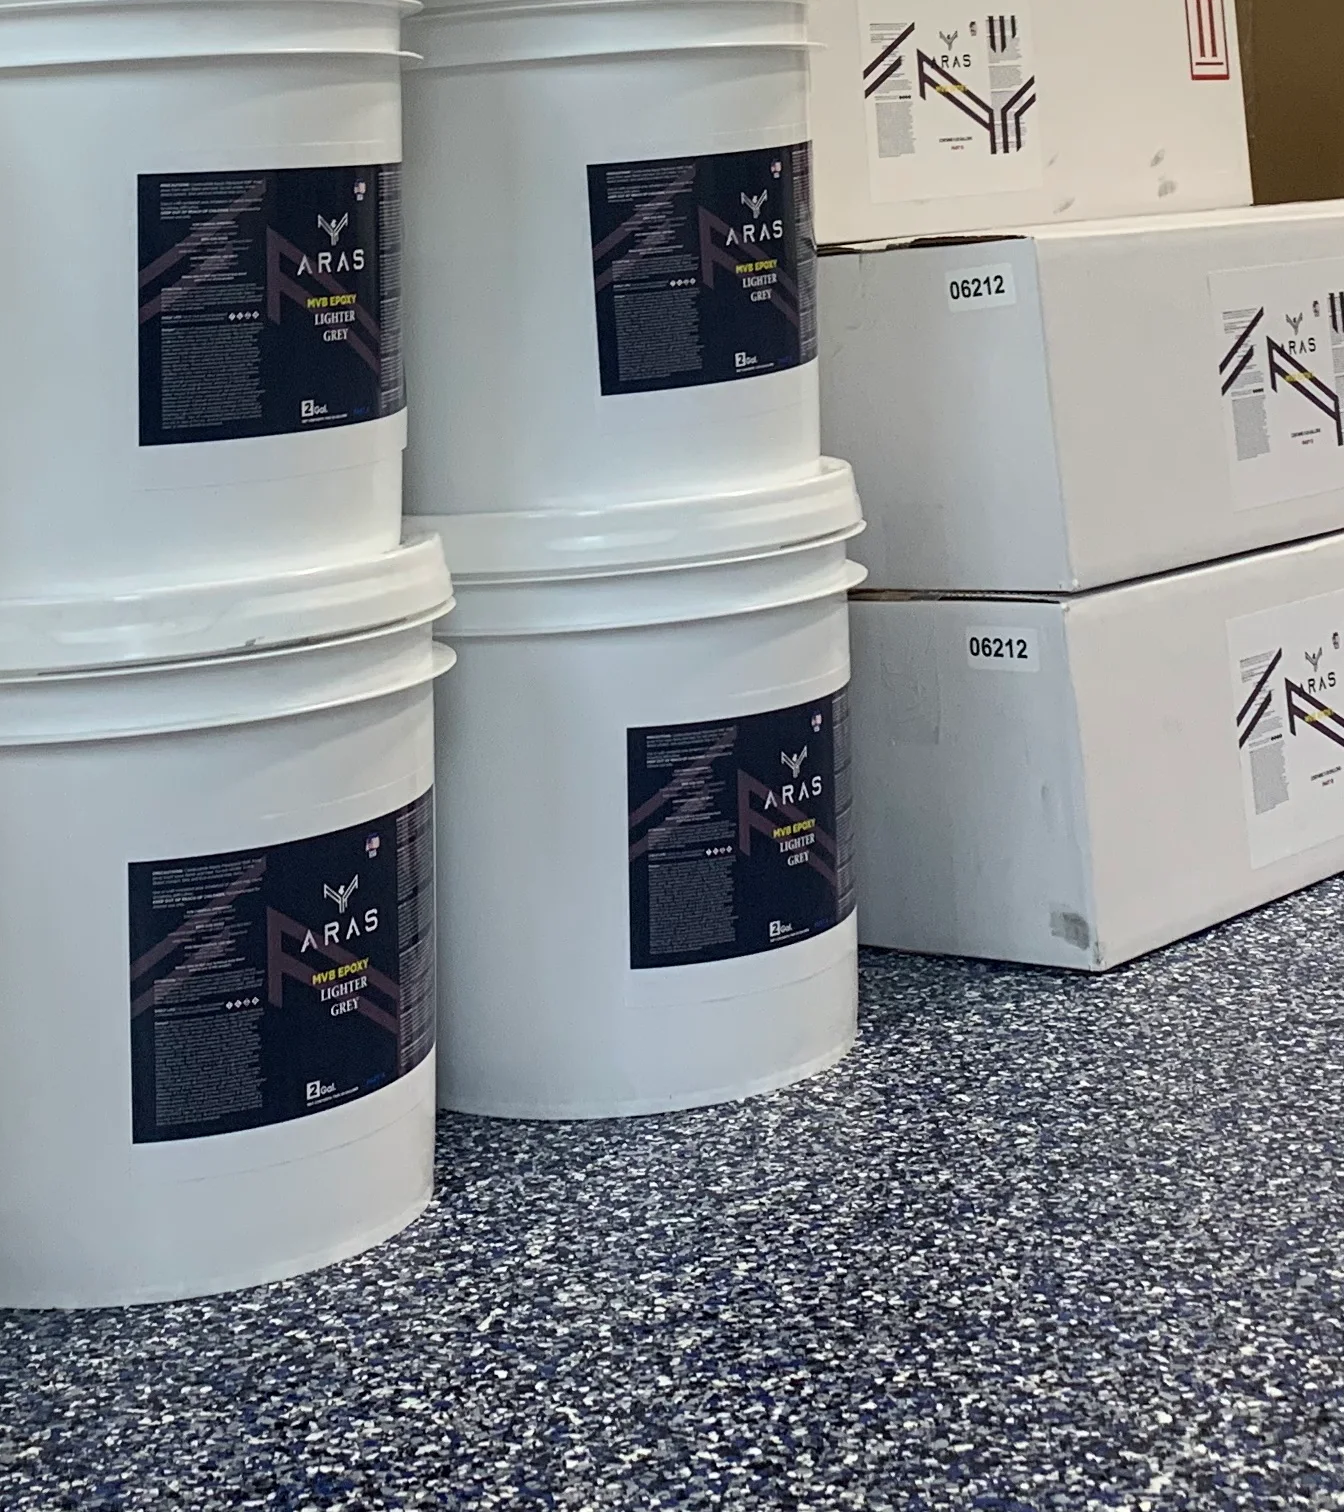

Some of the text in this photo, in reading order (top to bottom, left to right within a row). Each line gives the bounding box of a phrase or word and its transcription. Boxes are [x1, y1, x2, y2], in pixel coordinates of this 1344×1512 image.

[726, 220, 783, 246] ARAS
[297, 249, 365, 276] ARAS
[742, 274, 777, 288] LIGHTER
[949, 274, 1005, 301] 06212
[307, 293, 356, 309] MVB EPOXY
[750, 289, 772, 302] GREY
[314, 310, 355, 326] LIGHTER
[323, 328, 348, 342] GREY
[969, 635, 1028, 660] 06212
[764, 776, 822, 809] ARAS
[779, 833, 815, 853] LIGHTER
[787, 850, 809, 867] GREY
[300, 908, 378, 953] ARAS
[312, 957, 370, 986] MVB EPOXY
[320, 975, 368, 1002] LIGHTER
[330, 996, 360, 1017] GREY
